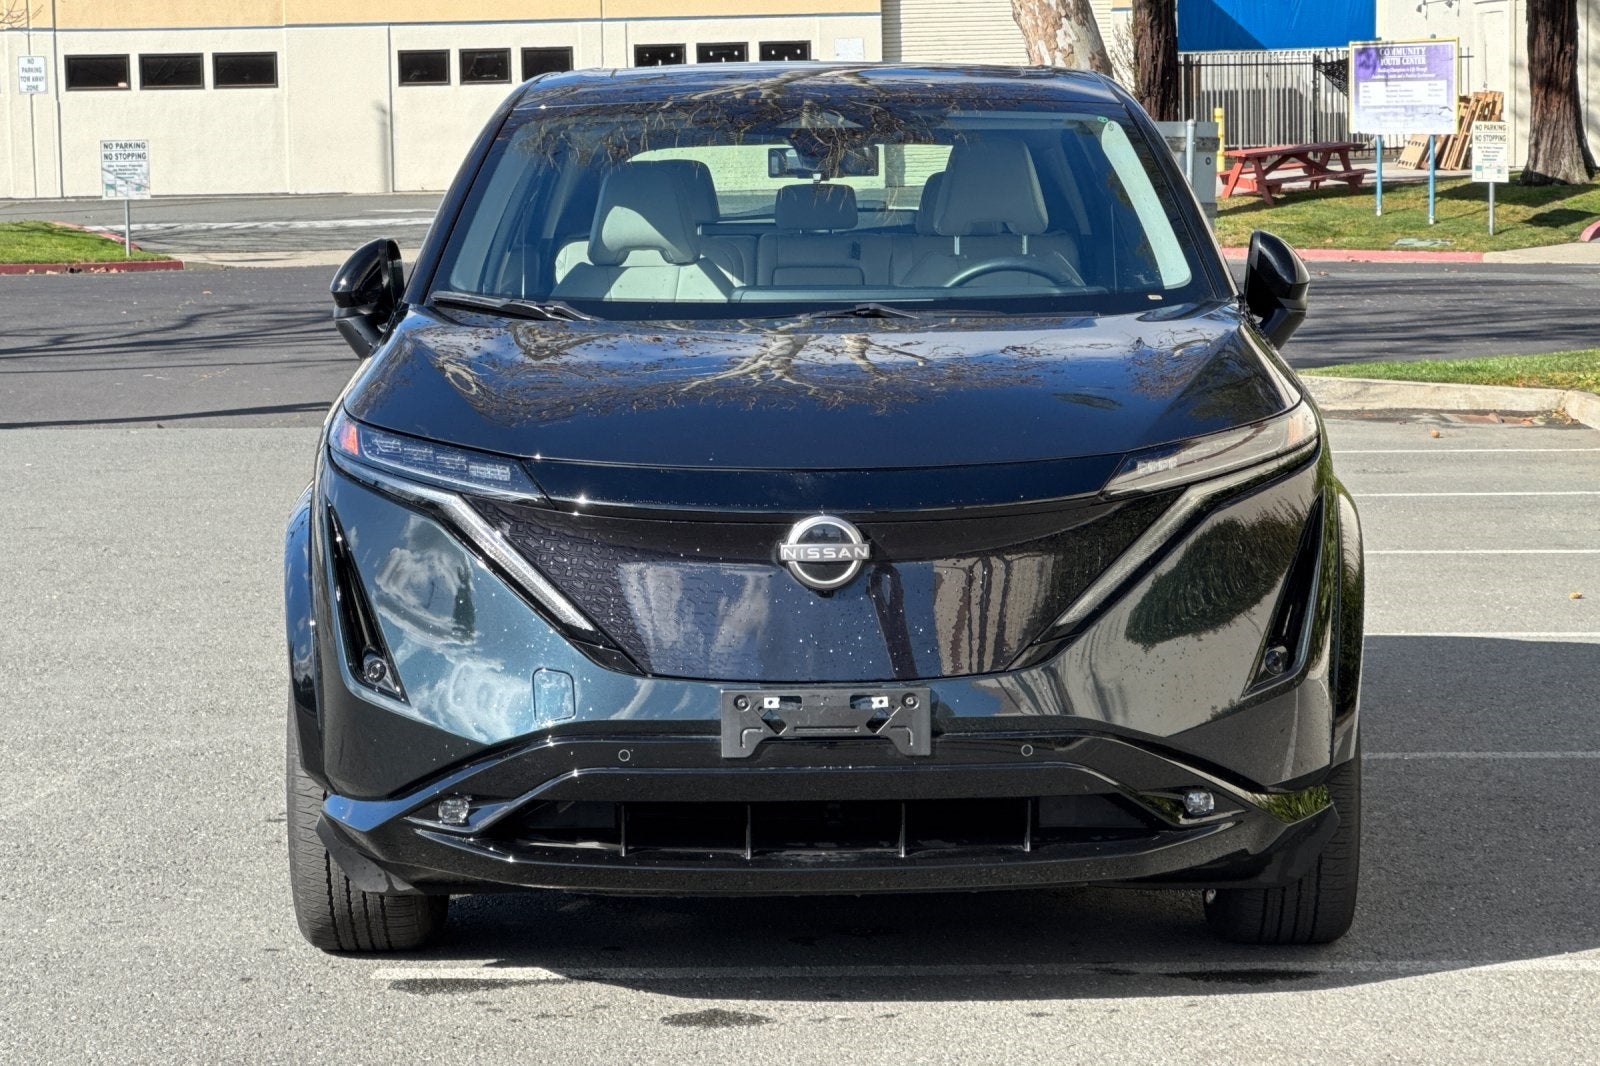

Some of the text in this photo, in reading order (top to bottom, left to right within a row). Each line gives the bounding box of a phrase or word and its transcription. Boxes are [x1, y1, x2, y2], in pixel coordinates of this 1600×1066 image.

[1380, 47, 1426, 56] COMMUNITY
[1381, 57, 1426, 66] YOUTH CENTER
[1483, 134, 1507, 142] STOPPING
[115, 142, 146, 150] PARKING
[114, 152, 147, 160] STOPPING
[783, 547, 867, 560] NISSAN
